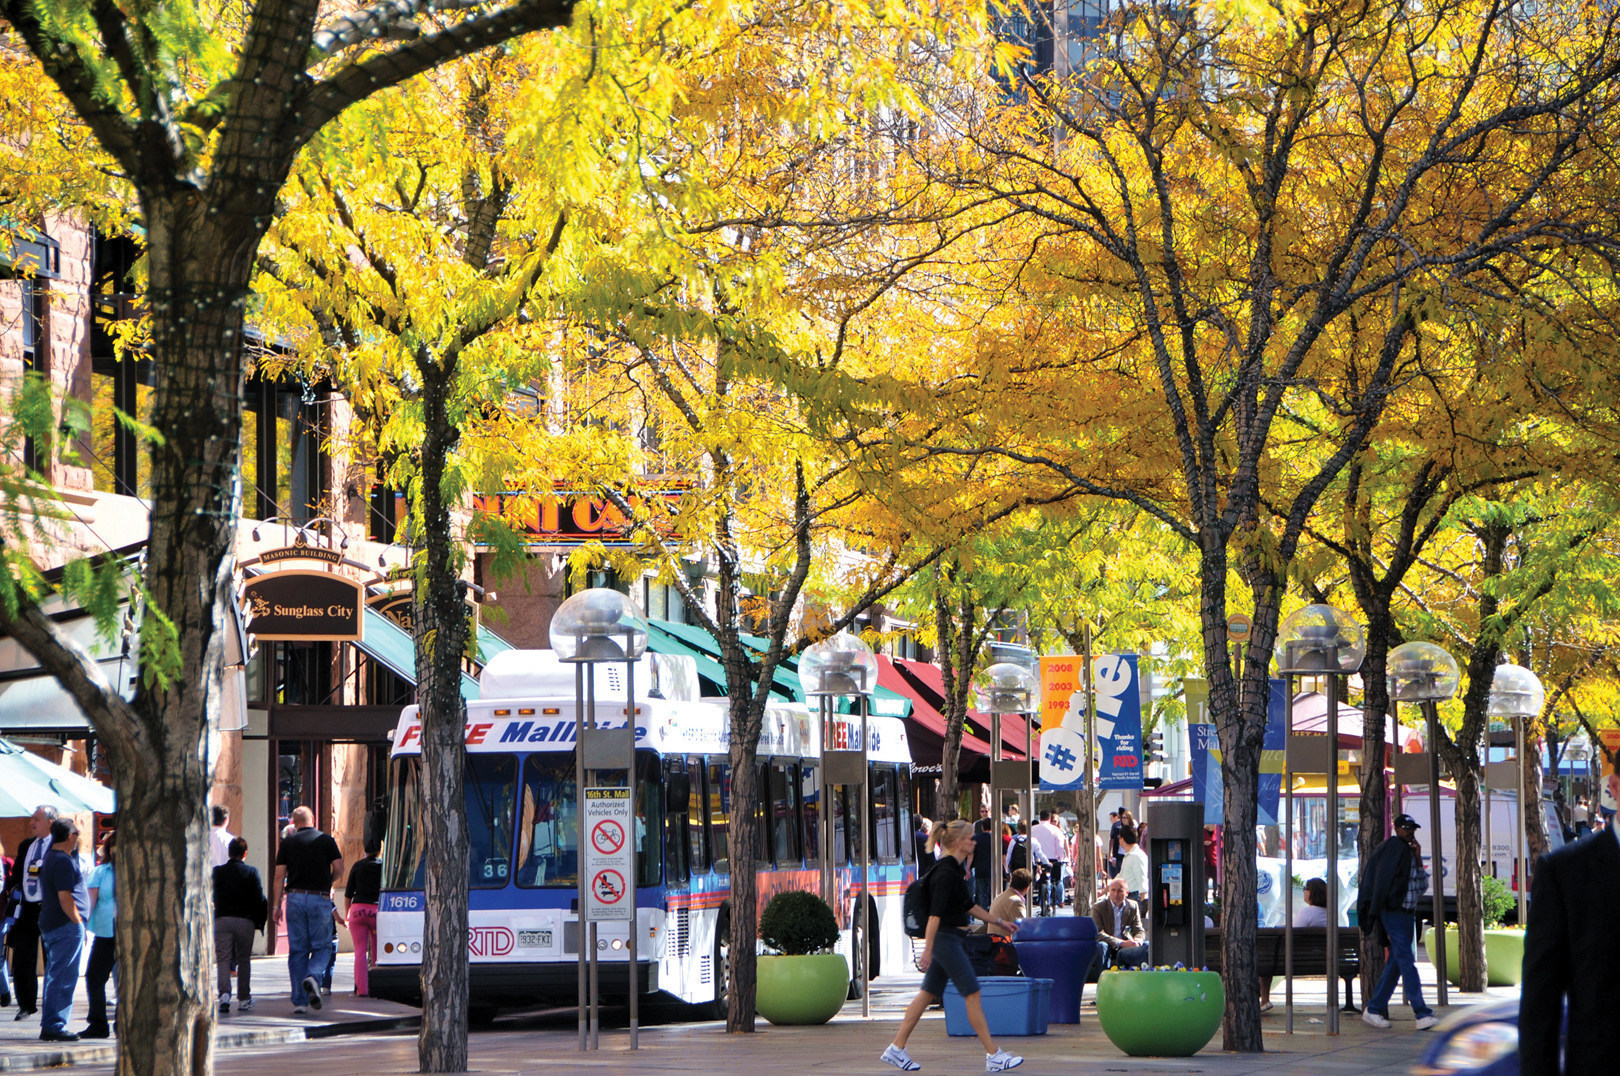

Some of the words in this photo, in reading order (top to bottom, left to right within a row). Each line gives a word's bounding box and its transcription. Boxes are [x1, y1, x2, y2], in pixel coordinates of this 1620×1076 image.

[263, 550, 298, 561] MASONIC
[300, 550, 338, 561] BUILDING
[274, 605, 324, 619] Sunglass
[327, 605, 354, 620] City
[1048, 664, 1073, 673] 2008
[1048, 682, 1073, 691] 2003
[1048, 700, 1071, 709] 1993
[398, 723, 494, 748] FE
[500, 721, 648, 743] Malle
[1197, 738, 1220, 750] Mal
[1112, 755, 1138, 768] RTD
[587, 790, 601, 798] 16th
[614, 790, 630, 798] Mall
[614, 809, 628, 817] Only
[389, 896, 418, 908] 1616
